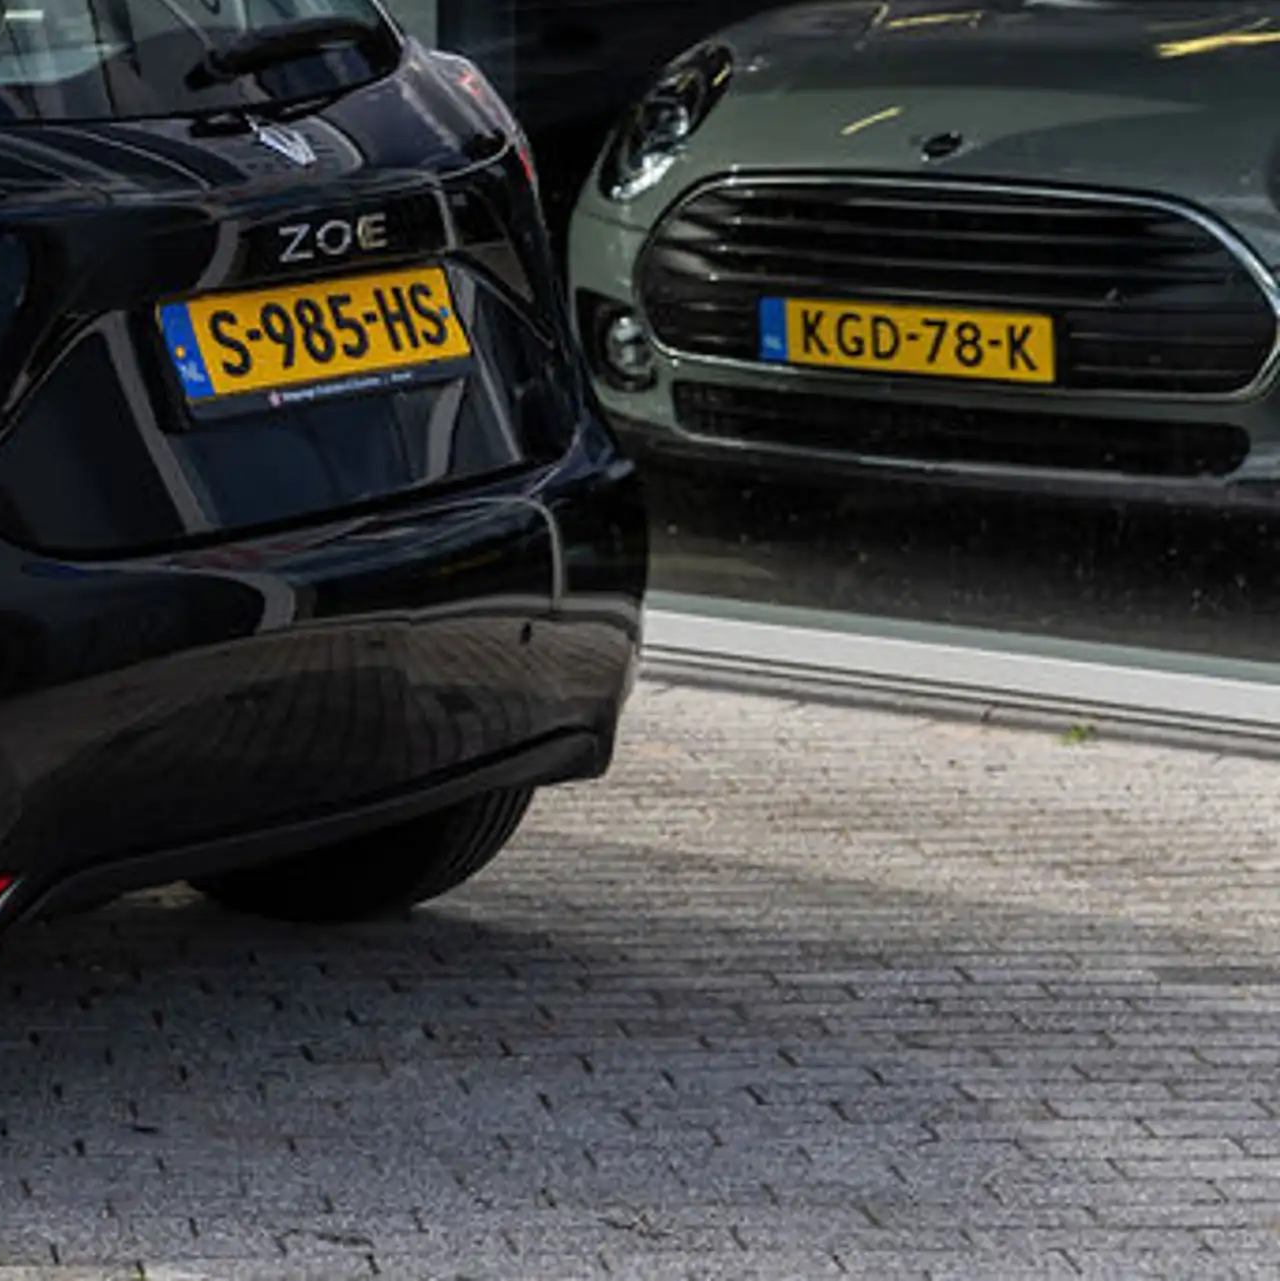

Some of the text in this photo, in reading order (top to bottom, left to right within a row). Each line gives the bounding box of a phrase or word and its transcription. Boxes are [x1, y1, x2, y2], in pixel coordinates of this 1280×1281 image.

[278, 213, 389, 263] ZOE
[209, 282, 448, 377] S-985-HS
[800, 309, 1038, 372] KGD-78-K
